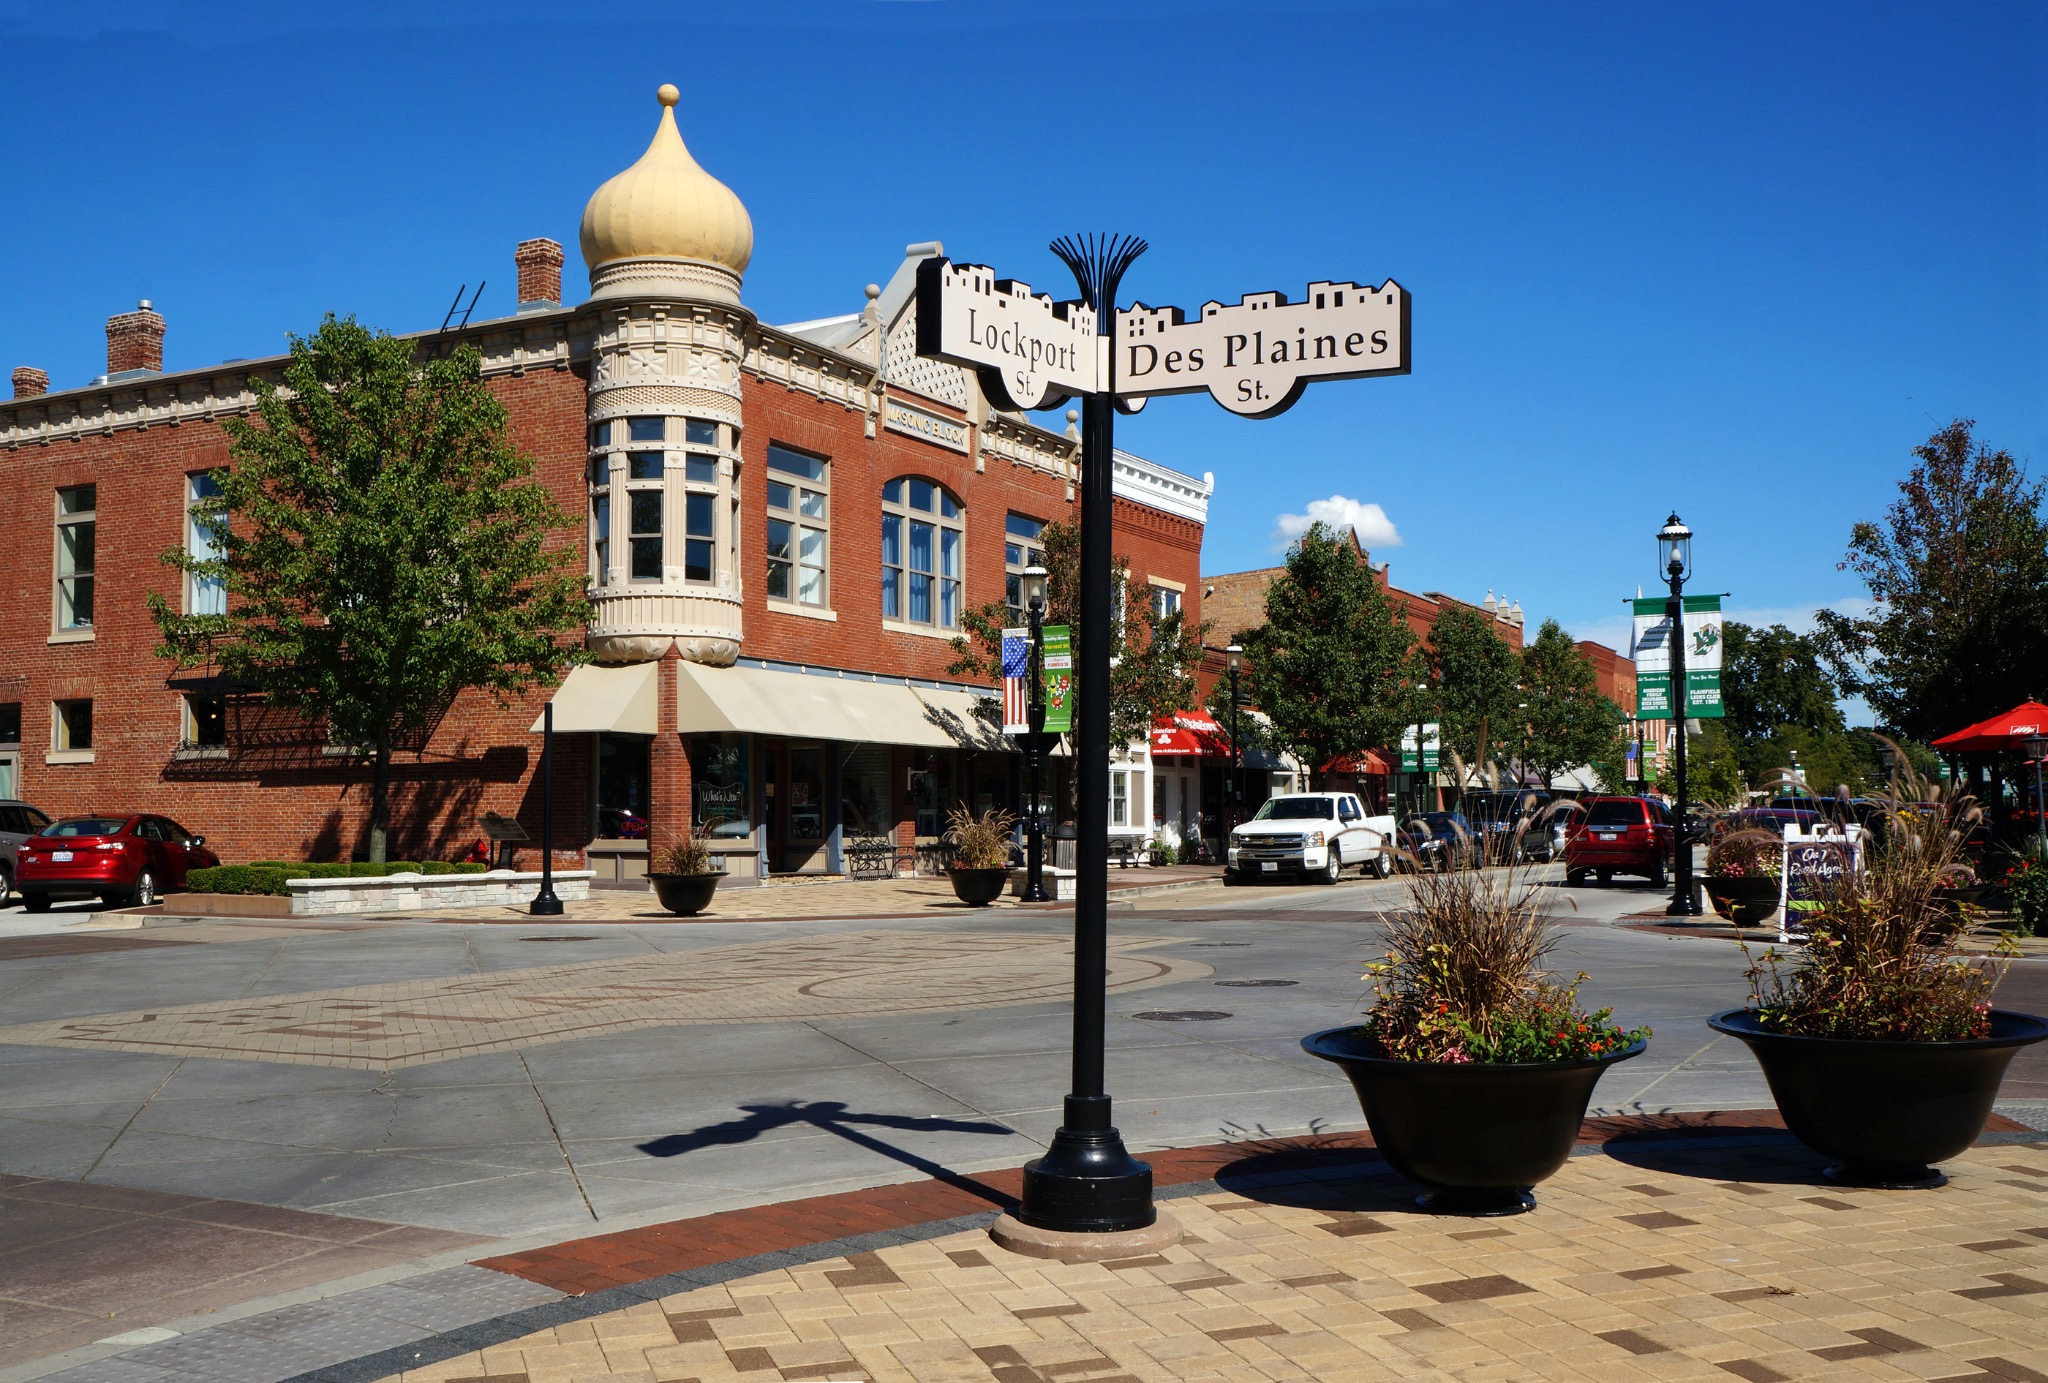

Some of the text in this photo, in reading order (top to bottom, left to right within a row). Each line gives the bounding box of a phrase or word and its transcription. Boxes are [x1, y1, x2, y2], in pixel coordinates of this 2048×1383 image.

[968, 307, 1076, 373] Lockport
[1127, 327, 1389, 377] Des Plaines
[1016, 370, 1034, 397] St.
[1237, 378, 1270, 402] St.
[887, 404, 965, 446] MASONIC BLOCK
[702, 790, 741, 802] What's New?
